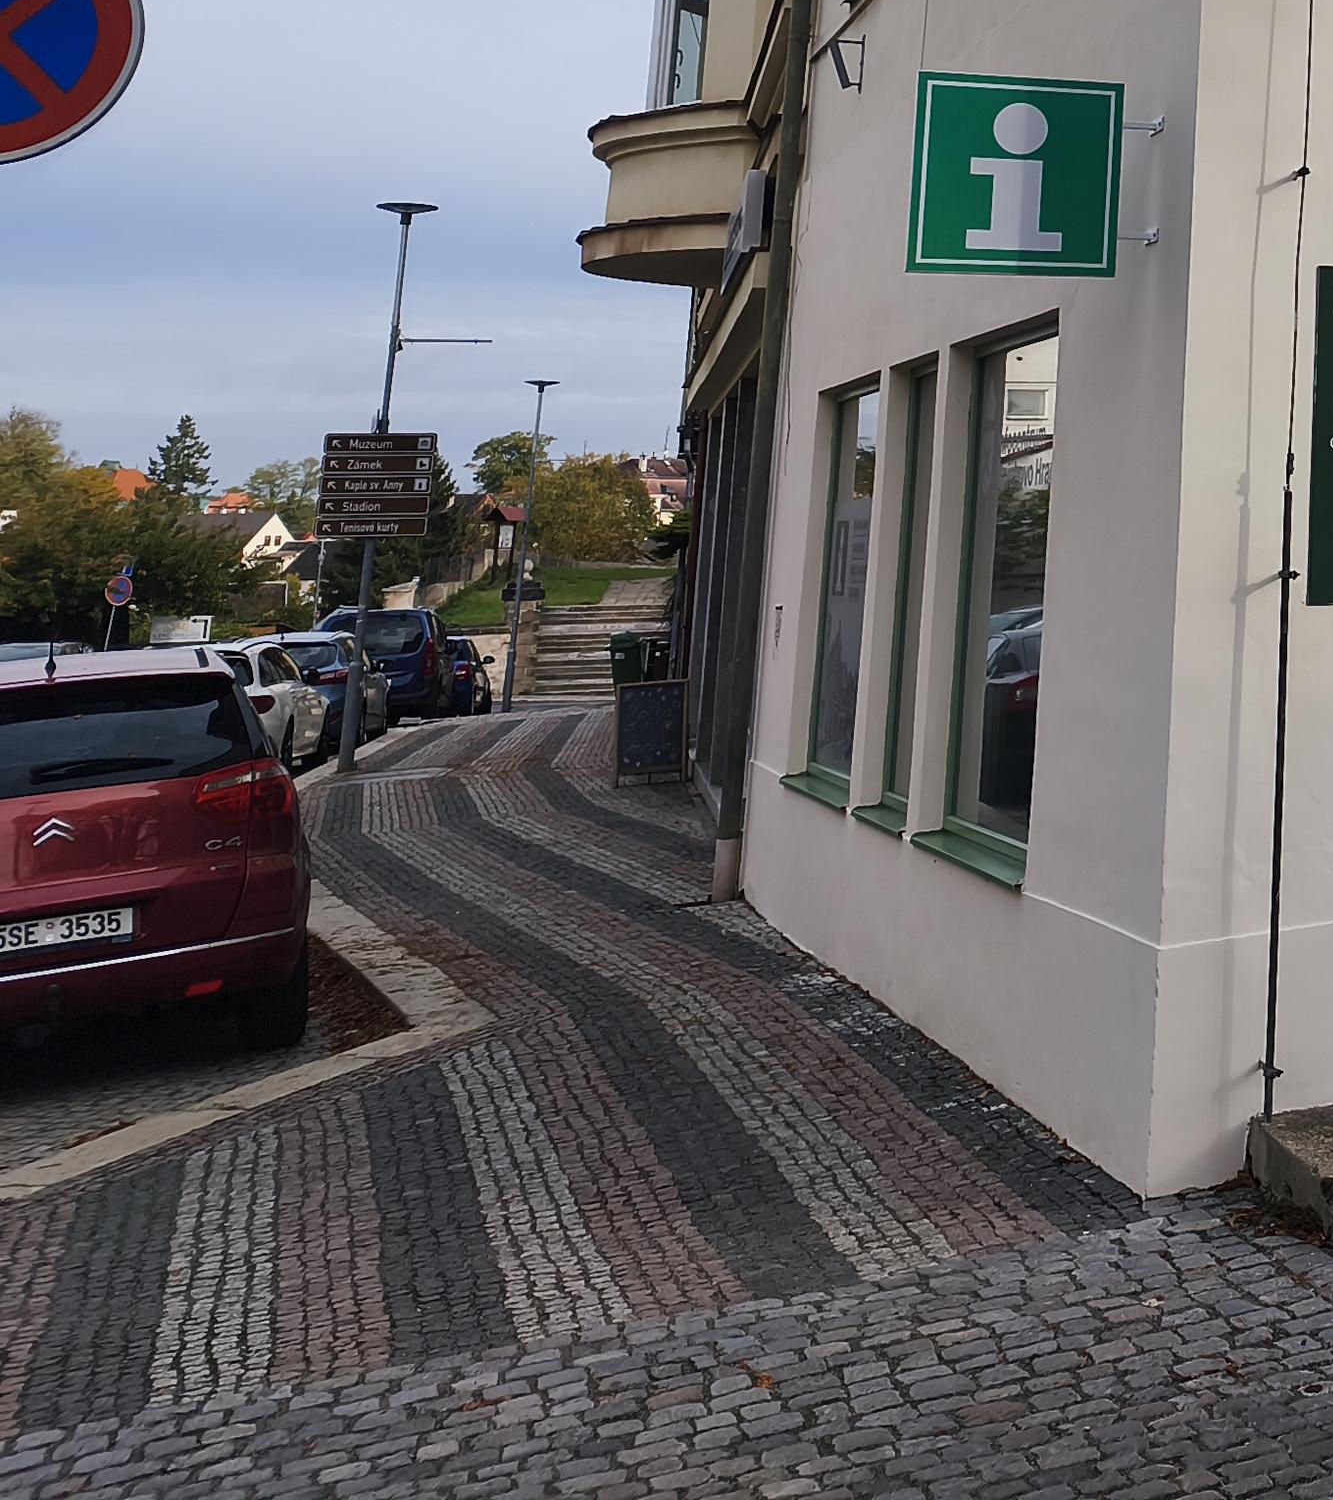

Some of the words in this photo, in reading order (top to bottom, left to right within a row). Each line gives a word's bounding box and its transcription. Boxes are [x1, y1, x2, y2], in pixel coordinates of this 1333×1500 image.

[349, 439, 392, 449] Muzeum
[347, 459, 383, 470] Zámek
[344, 480, 368, 492] Kaple
[383, 480, 404, 492] Anny
[342, 501, 381, 512] Stadion
[340, 521, 374, 533] Tenisové
[377, 521, 399, 533] kurty
[204, 835, 244, 850] C4
[60, 911, 122, 940] 3535
